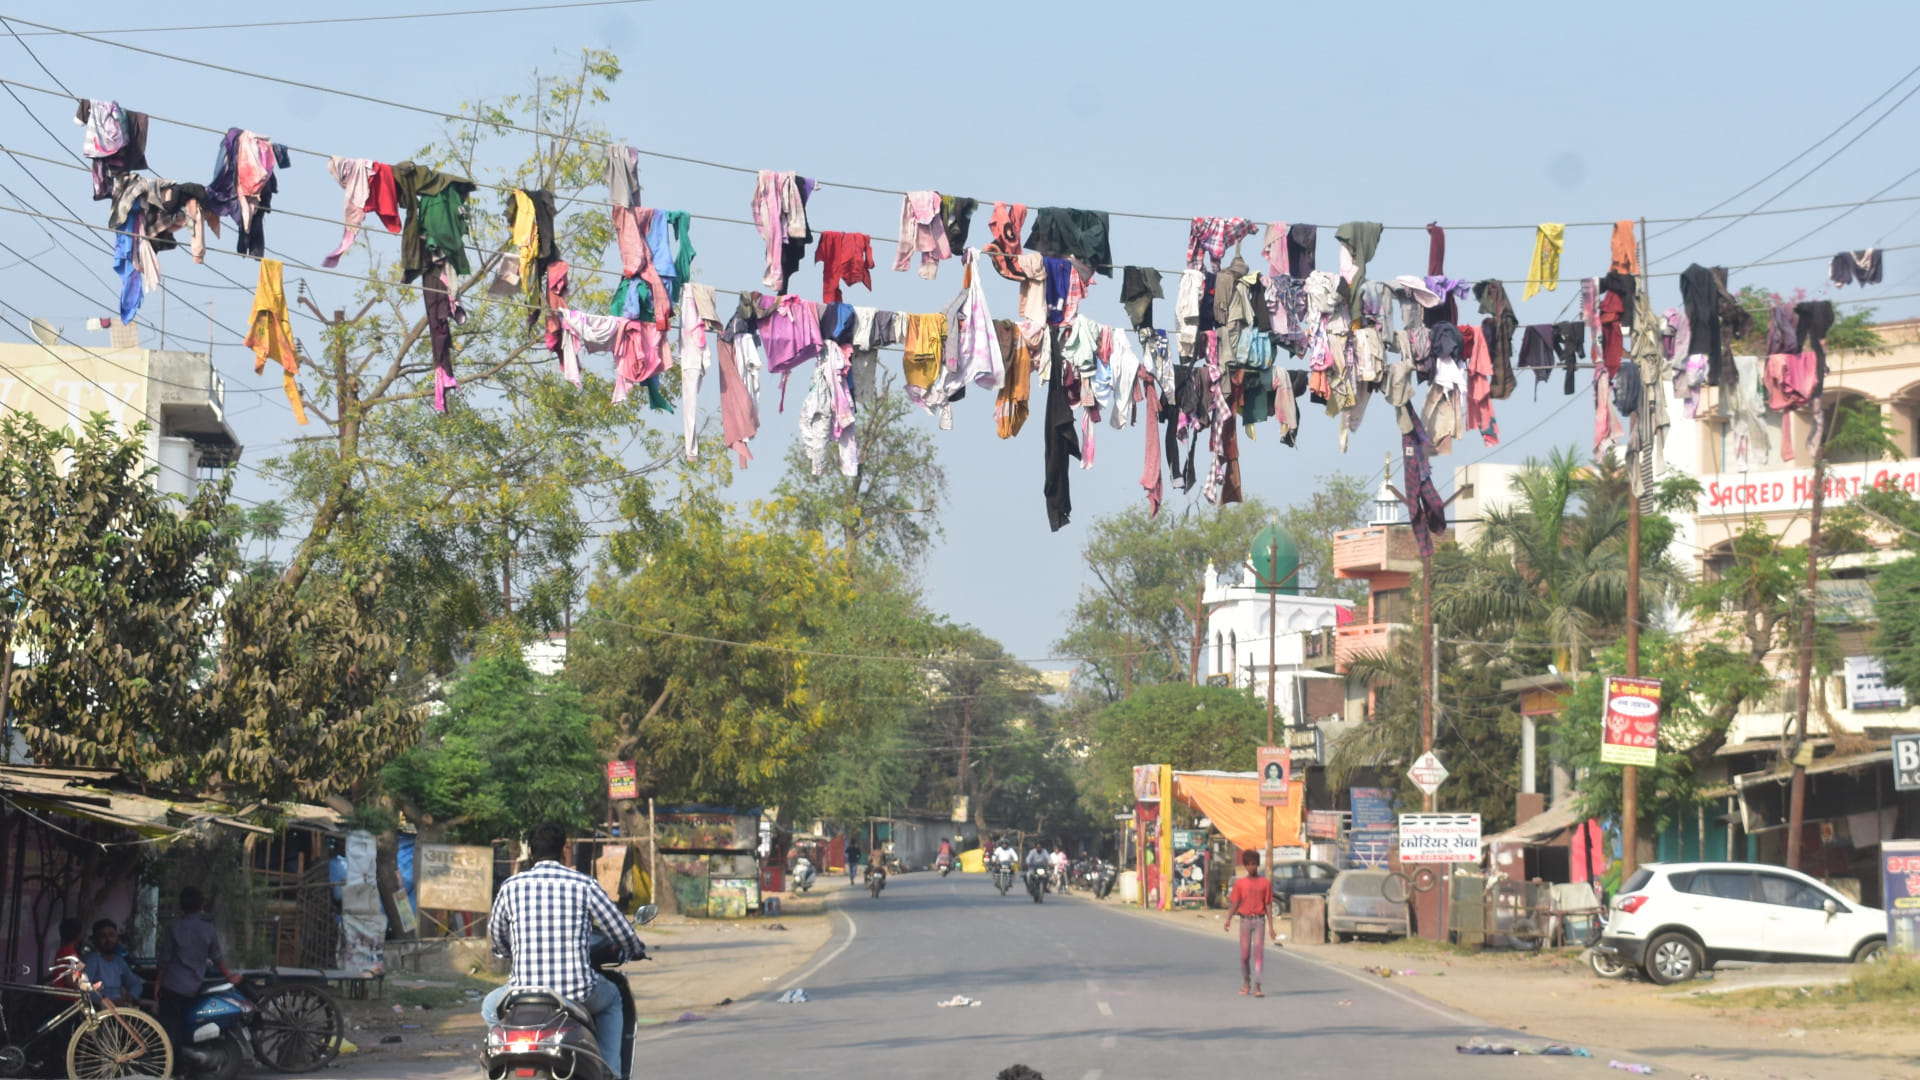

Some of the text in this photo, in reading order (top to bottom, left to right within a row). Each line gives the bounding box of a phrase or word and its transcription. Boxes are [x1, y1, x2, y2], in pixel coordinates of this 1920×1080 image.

[1709, 482, 1784, 507] SACRED
[1873, 469, 1920, 494] ACA
[1400, 833, 1478, 848] कोरियर सेवा
